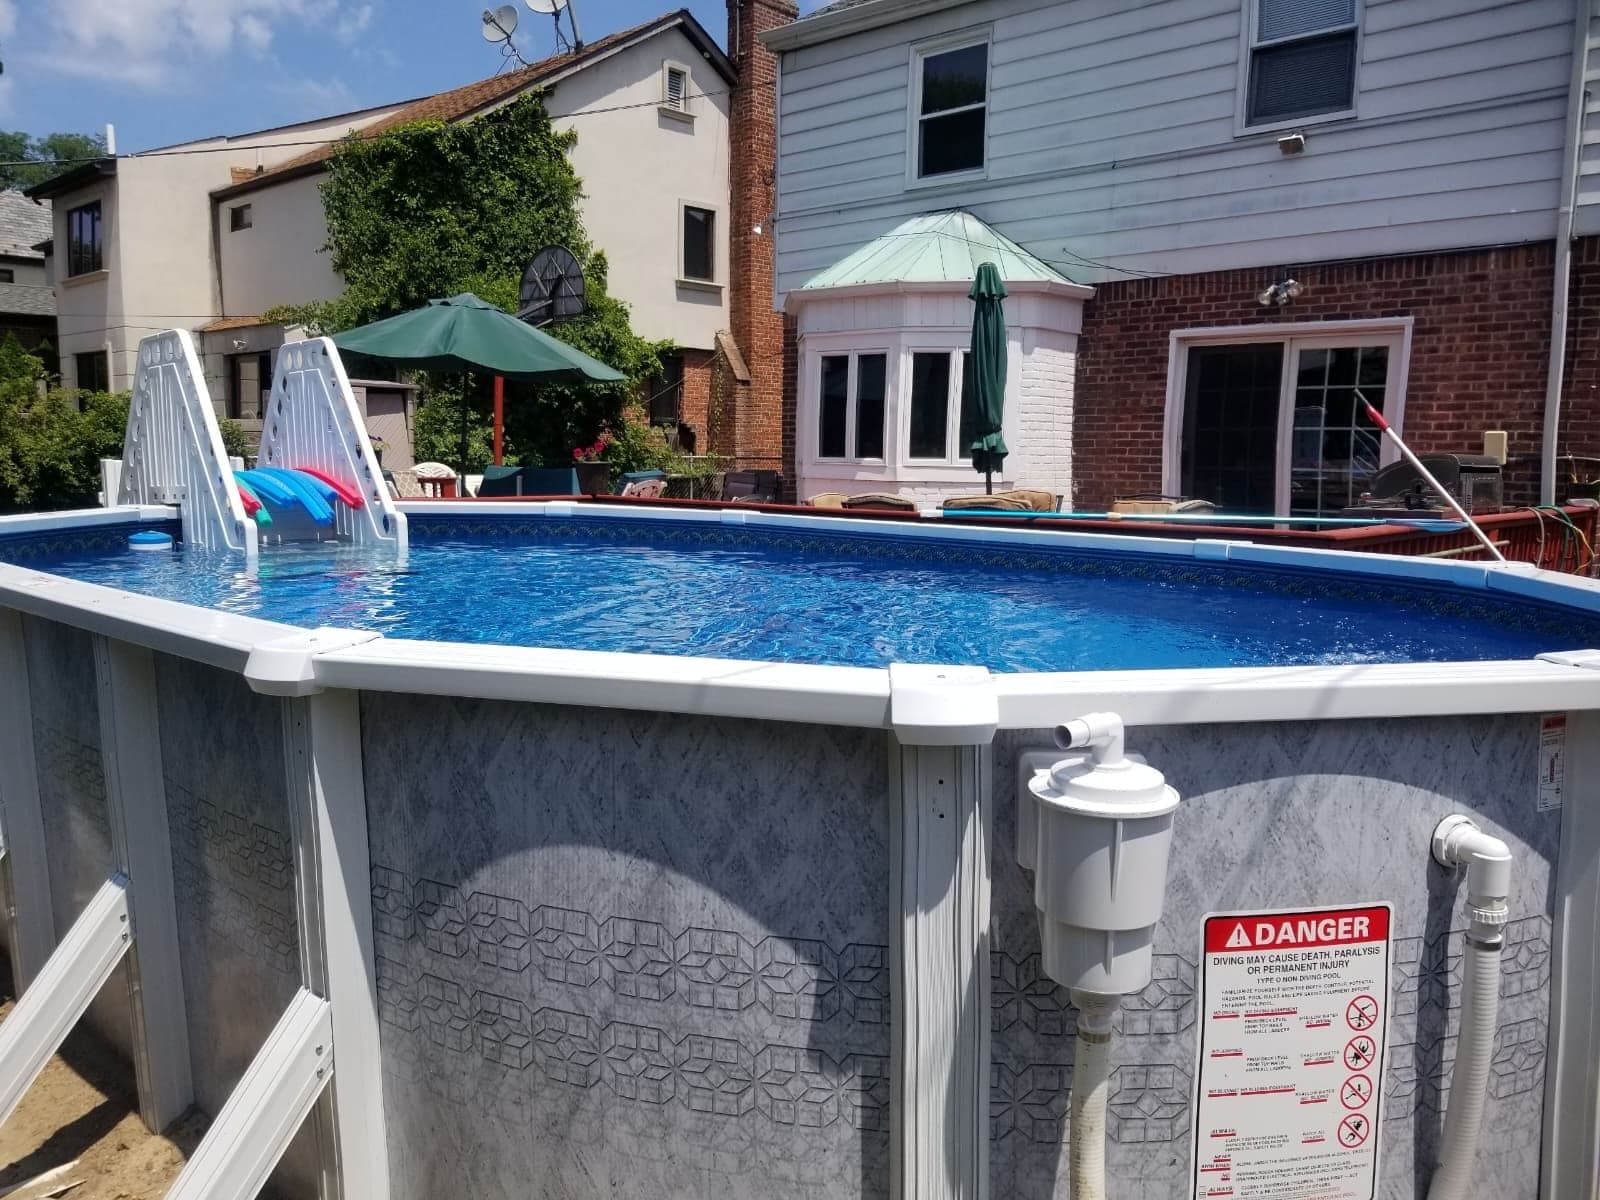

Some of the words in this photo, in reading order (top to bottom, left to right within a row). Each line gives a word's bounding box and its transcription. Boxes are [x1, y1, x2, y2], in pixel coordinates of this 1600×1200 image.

[1255, 916, 1370, 946] DANGER
[1213, 957, 1244, 966] DIVING
[1246, 955, 1266, 964] MAY
[1268, 953, 1299, 963] CAUSE
[1334, 946, 1381, 959] PARALYSIS
[1247, 966, 1261, 975] OR
[1263, 963, 1318, 974] PERMANENT
[1319, 960, 1350, 970] INJURY
